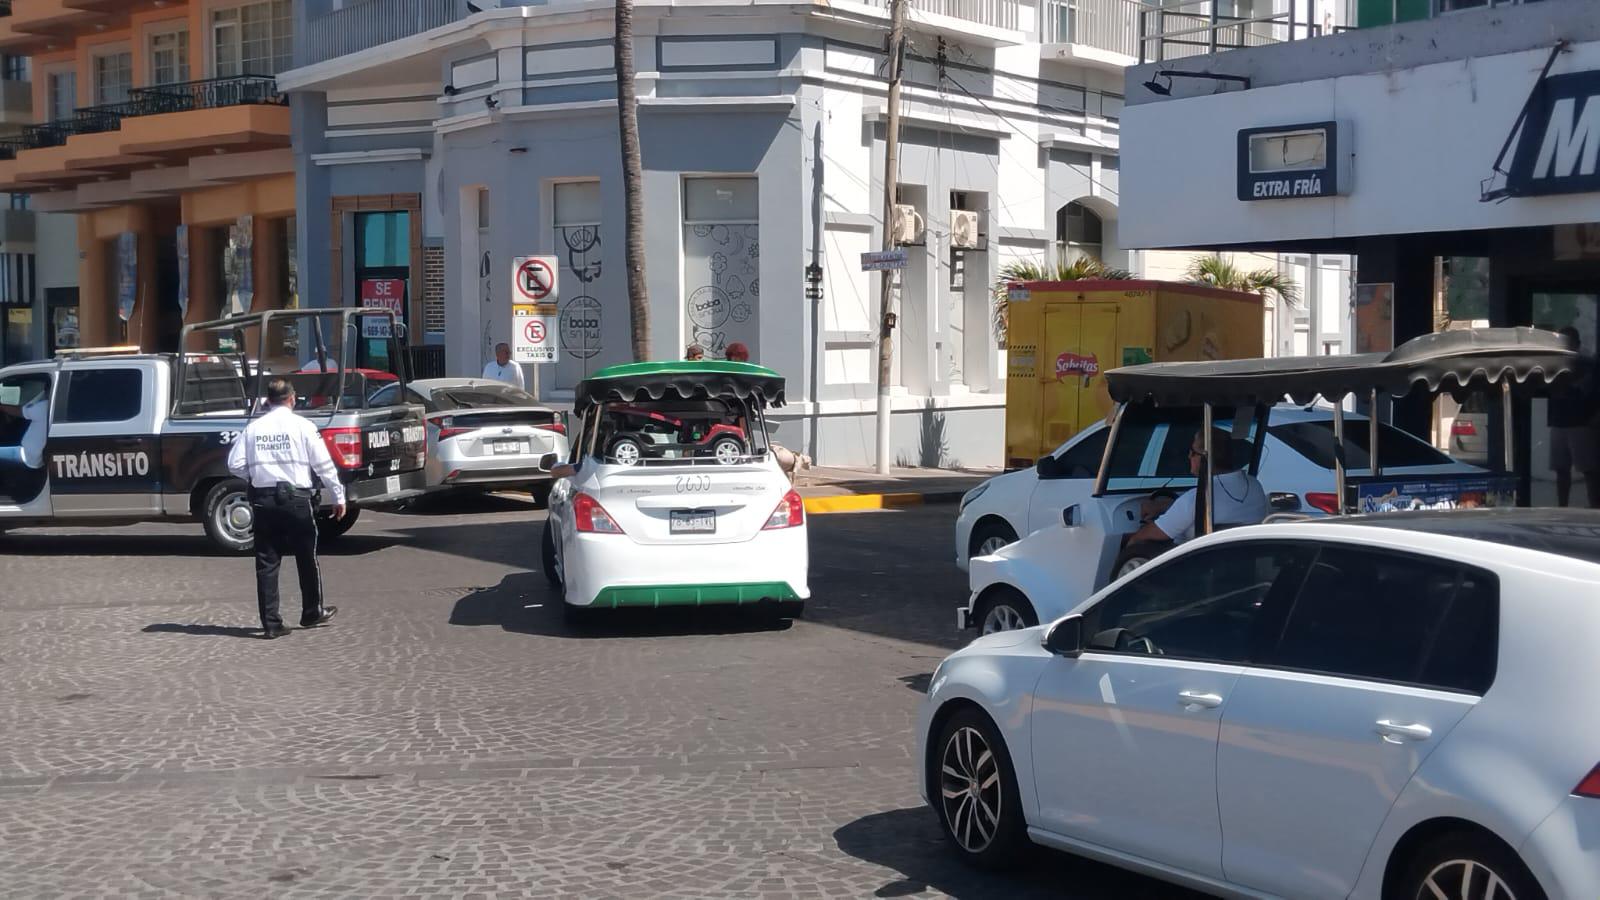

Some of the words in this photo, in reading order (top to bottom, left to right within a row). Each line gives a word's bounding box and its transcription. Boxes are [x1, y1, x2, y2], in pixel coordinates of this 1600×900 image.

[1253, 180, 1290, 197] EXTRA
[1293, 173, 1322, 195] FRÍA
[375, 281, 392, 295] SE
[570, 316, 598, 328] boba
[1056, 358, 1098, 373] Sabritas
[53, 451, 149, 478] TRÁNSITO
